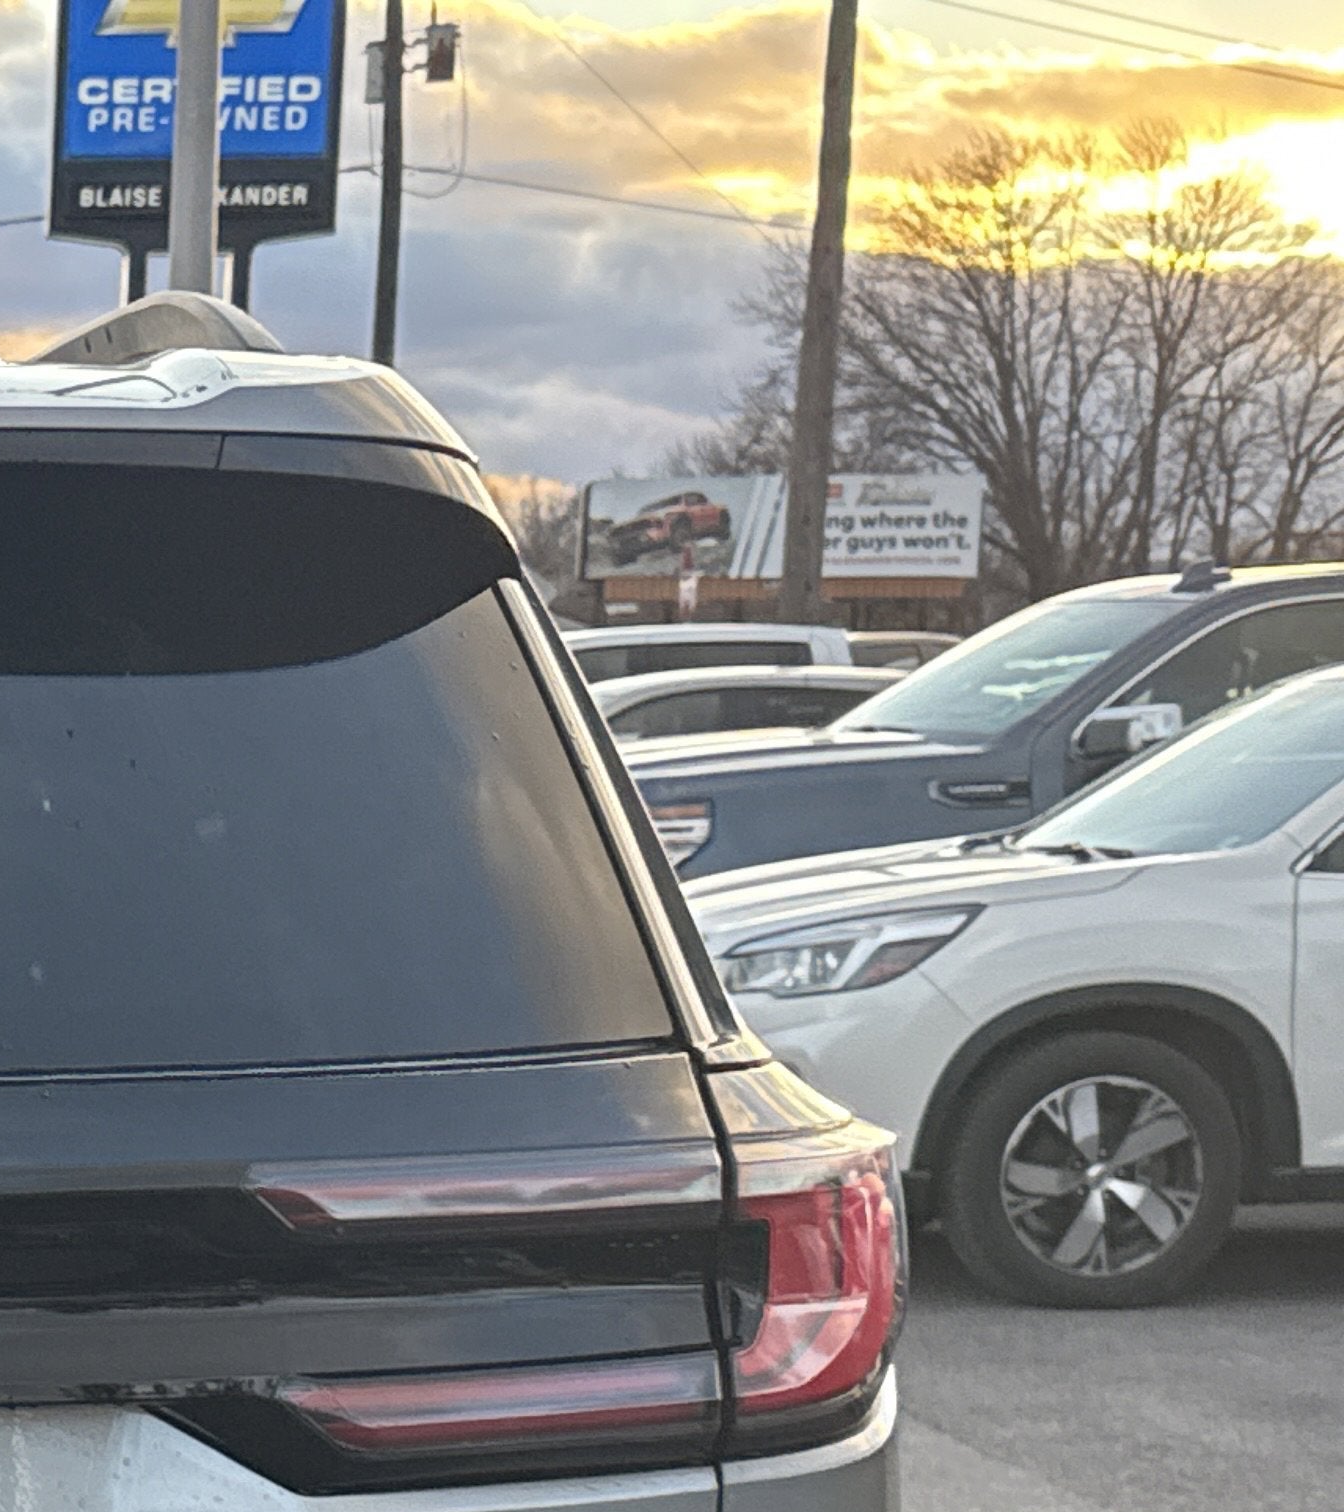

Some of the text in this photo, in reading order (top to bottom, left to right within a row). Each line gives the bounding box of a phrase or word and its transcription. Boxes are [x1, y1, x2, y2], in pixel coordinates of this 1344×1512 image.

[77, 76, 322, 105] CERFIED
[87, 105, 309, 133] PRE-NED
[79, 184, 308, 208] BLAISE XANDER
[860, 511, 927, 529] where
[932, 511, 968, 529] the
[846, 536, 897, 554] guys
[902, 533, 971, 550] won't.
